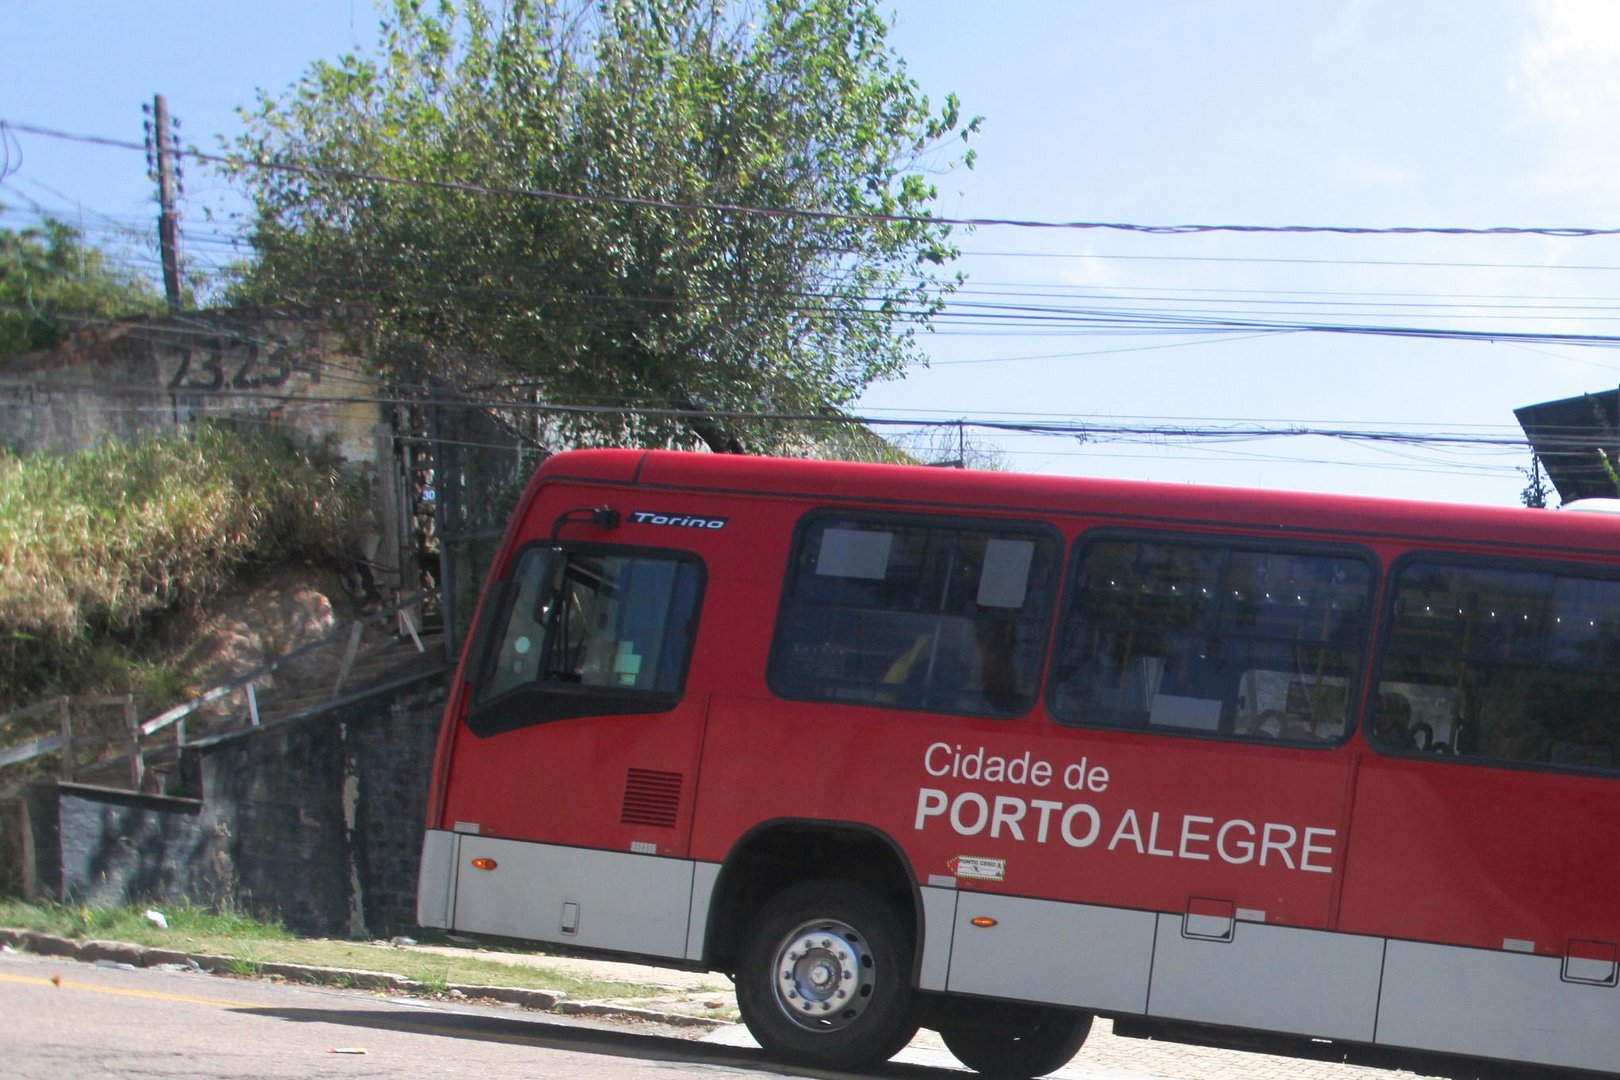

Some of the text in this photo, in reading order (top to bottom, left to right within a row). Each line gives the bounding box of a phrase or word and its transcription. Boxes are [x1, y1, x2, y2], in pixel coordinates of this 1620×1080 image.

[634, 511, 725, 529] Torino
[924, 742, 1110, 792] Cidade de
[914, 787, 1337, 874] PORTO ALEGRE
